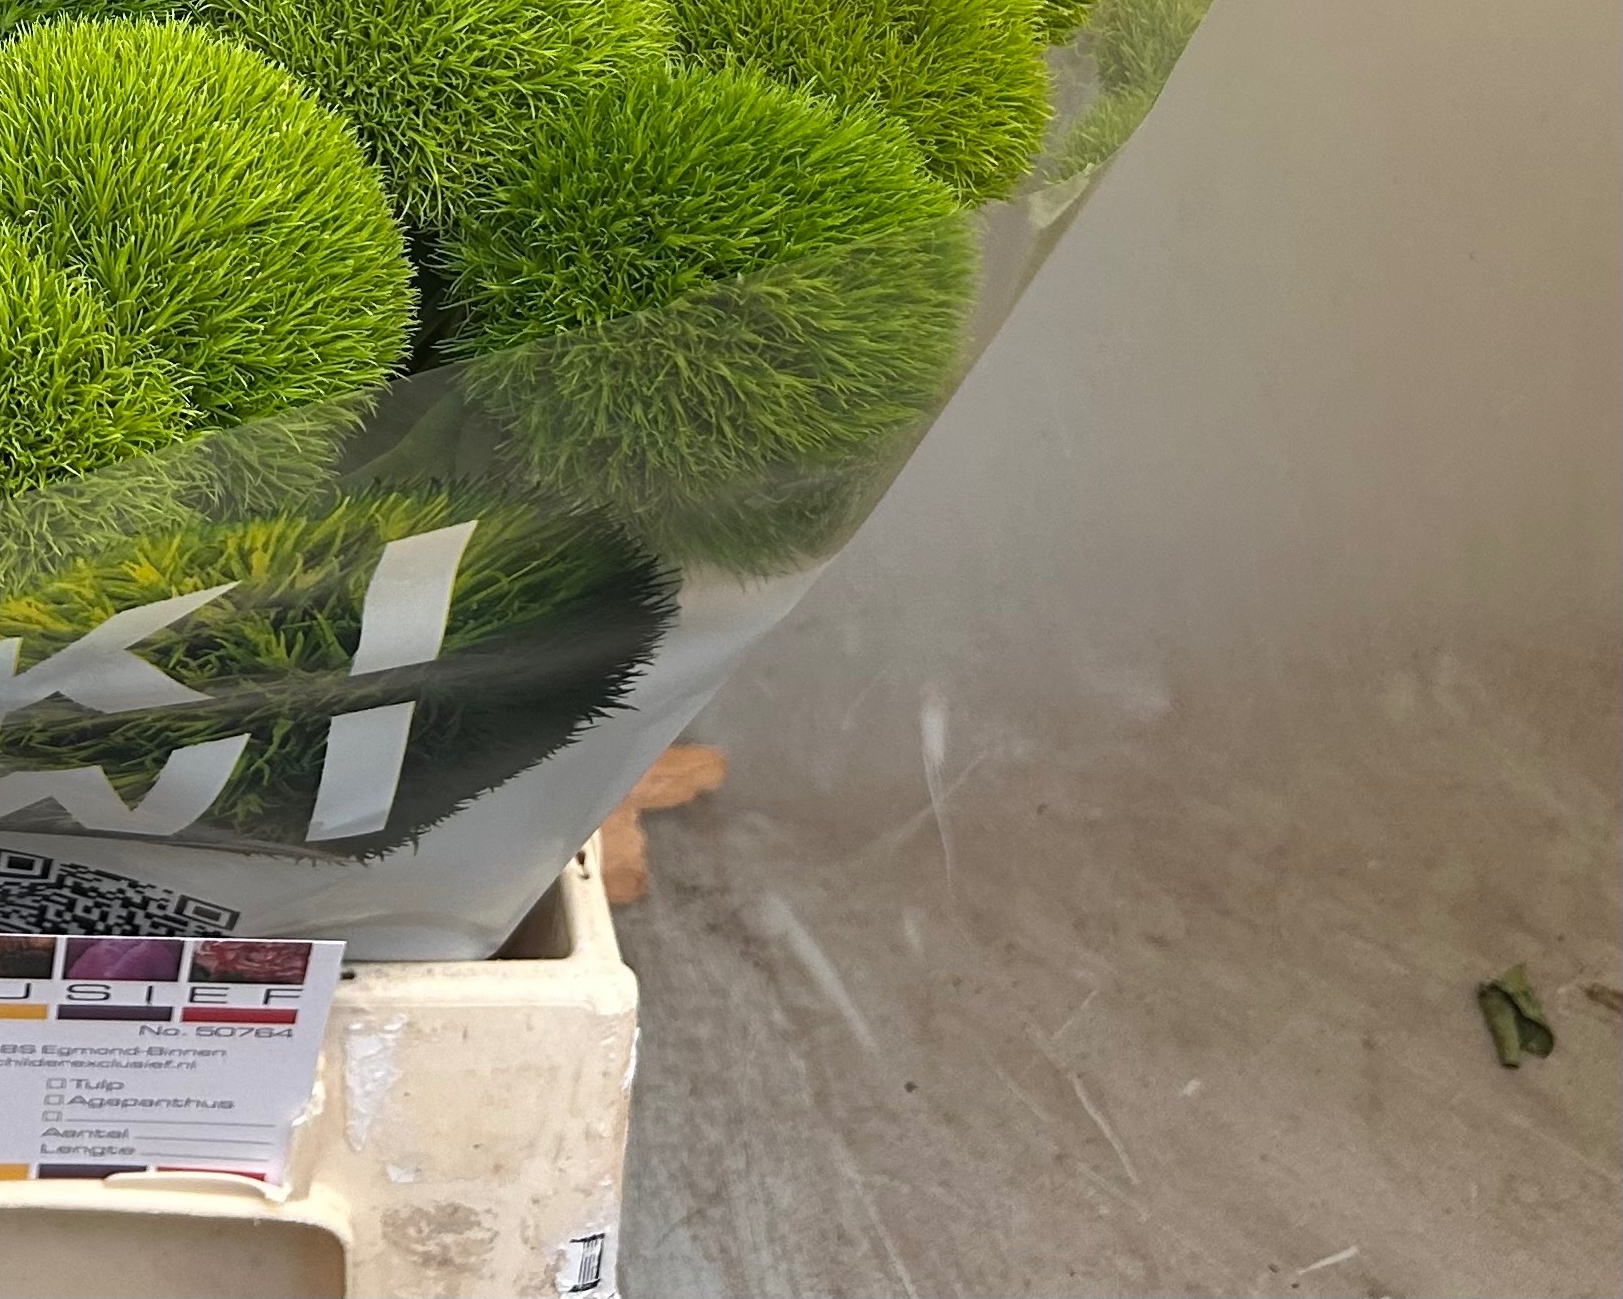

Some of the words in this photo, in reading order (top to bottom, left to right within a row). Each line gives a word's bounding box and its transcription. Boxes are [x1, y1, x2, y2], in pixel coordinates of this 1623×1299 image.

[138, 1024, 187, 1037] No.
[195, 1026, 293, 1039] 50764
[69, 1077, 126, 1091] Tulp
[66, 1094, 235, 1110] Agapanthus
[40, 1126, 130, 1140] Aantal
[39, 1143, 137, 1158] Lengte
